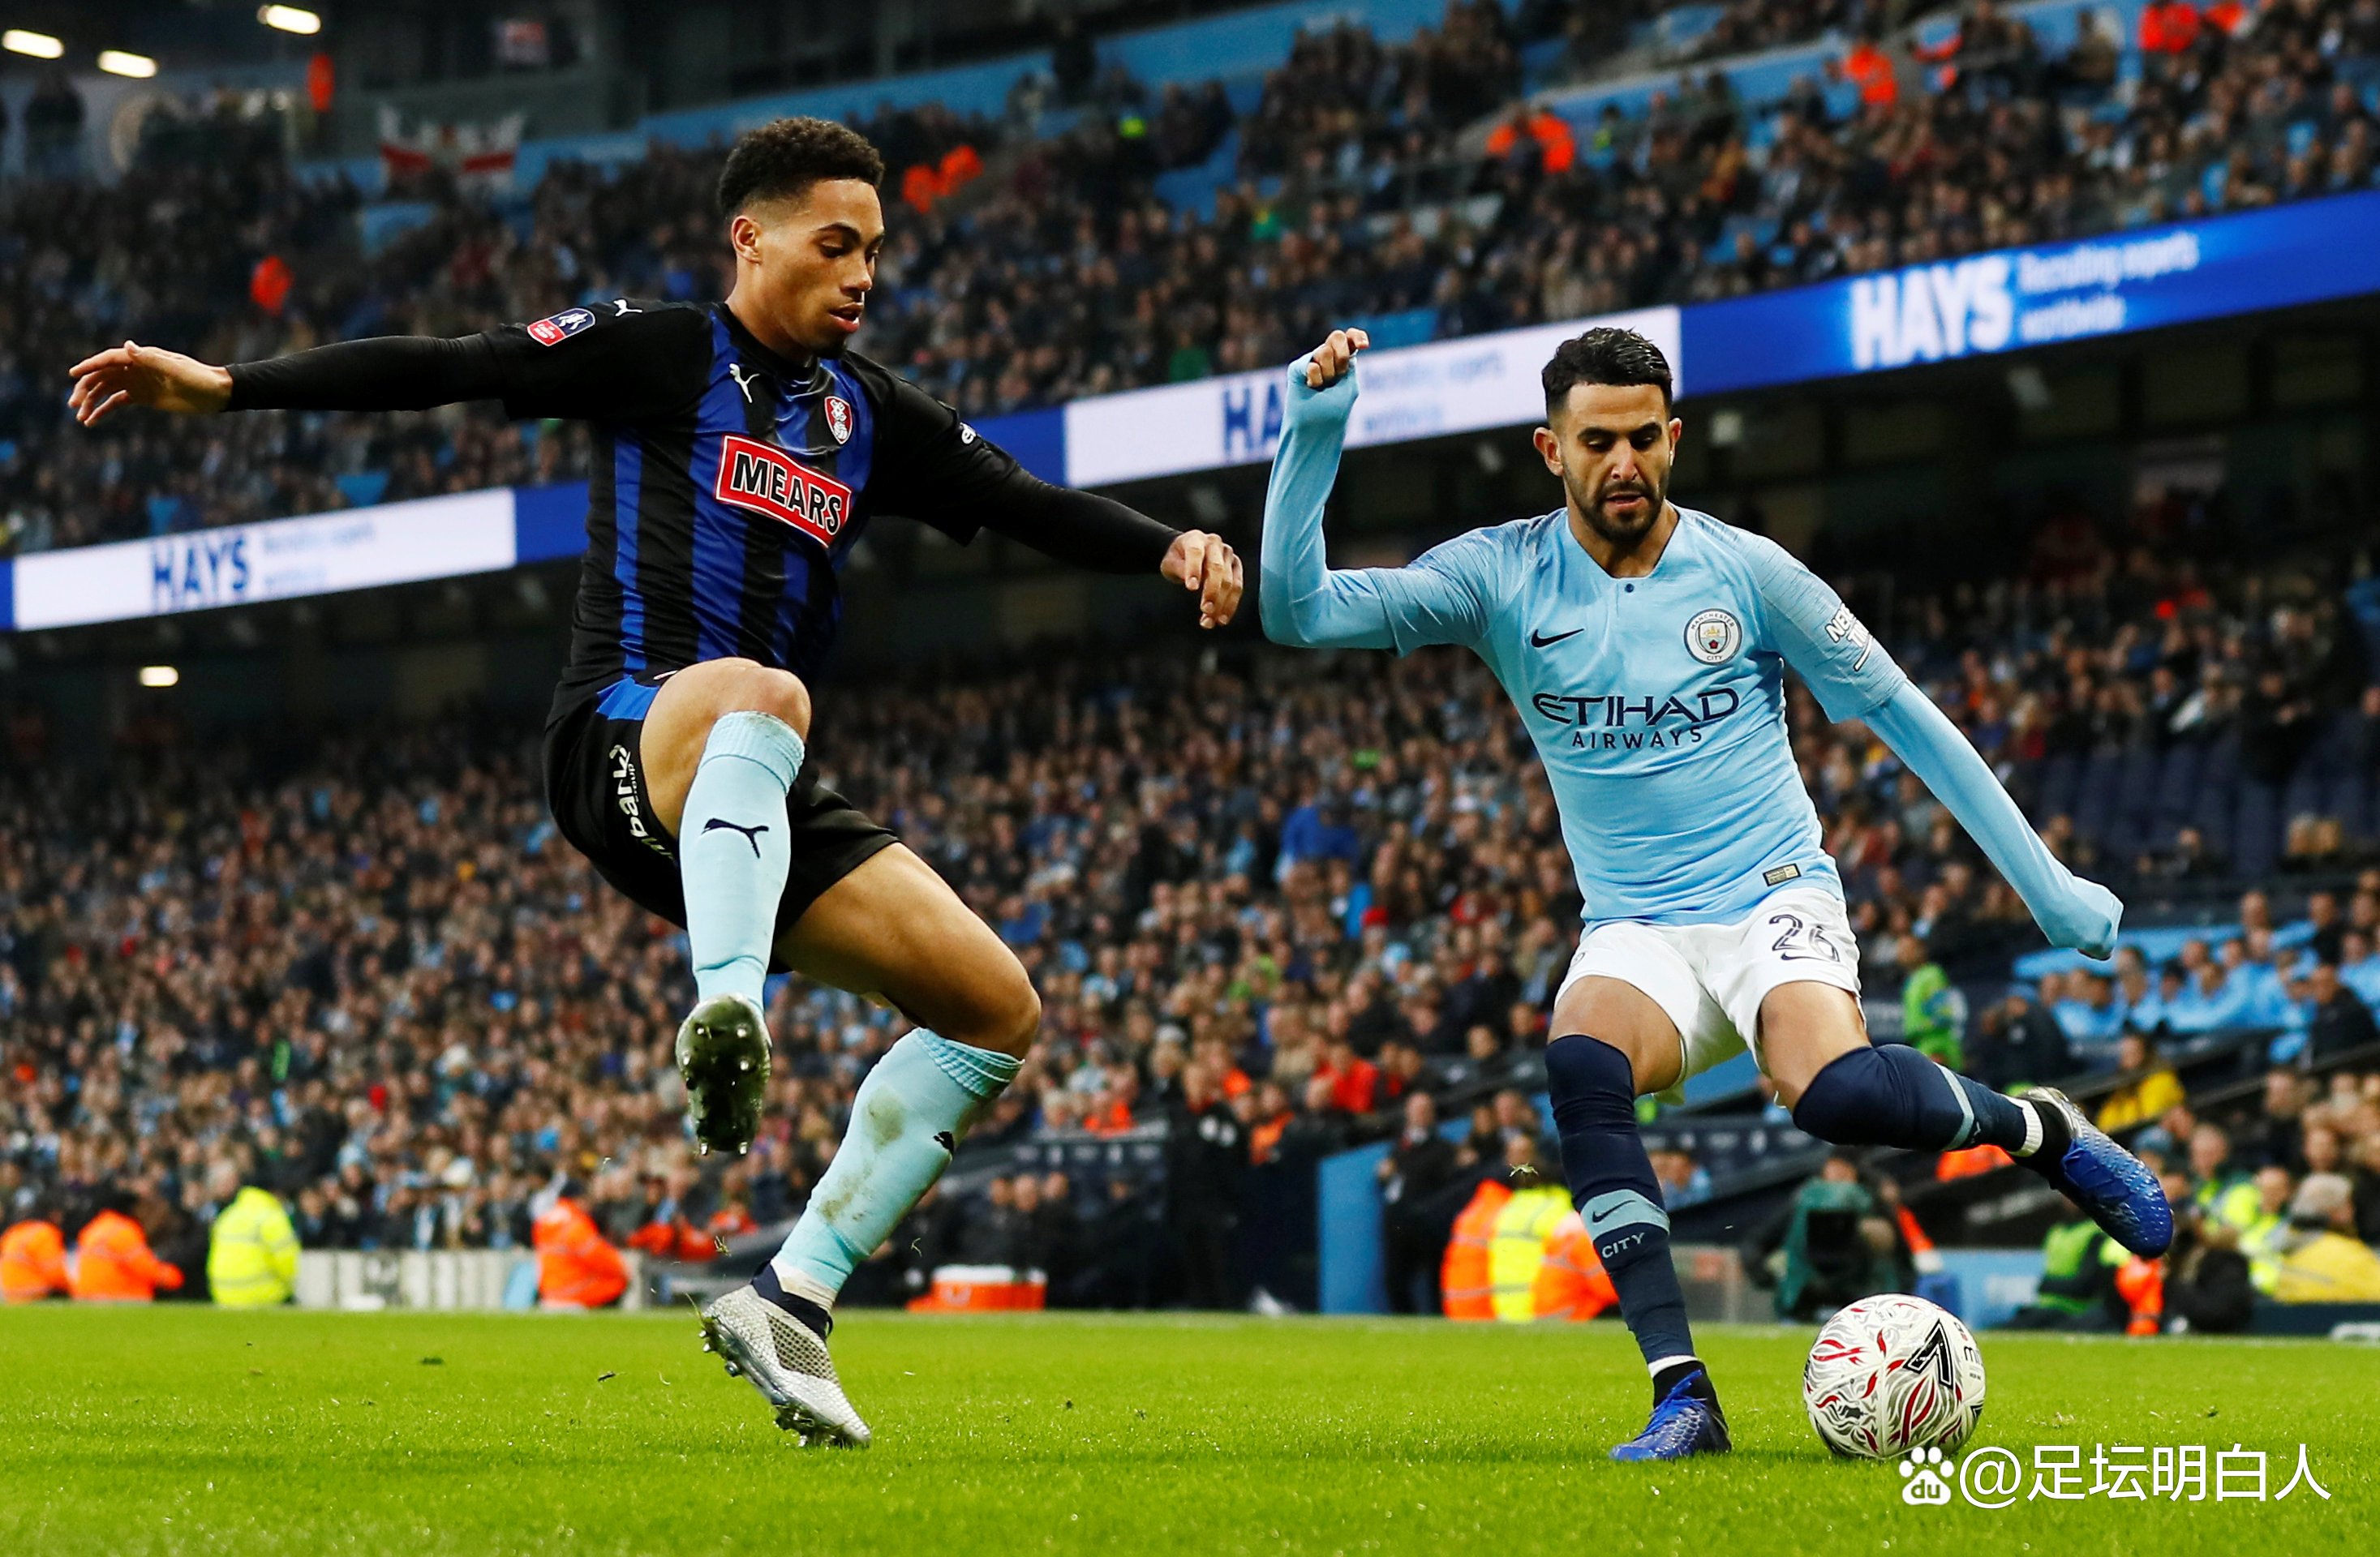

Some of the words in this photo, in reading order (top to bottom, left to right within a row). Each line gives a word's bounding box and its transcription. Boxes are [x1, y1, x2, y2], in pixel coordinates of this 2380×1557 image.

[1850, 253, 2012, 371] HAYS
[1222, 380, 1286, 461] HA
[731, 450, 842, 535] MEARS
[152, 530, 250, 610] HAYS
[1690, 613, 1735, 630] MANCHESTER
[1532, 688, 1739, 726] ETIHAD
[1572, 727, 1702, 748] AIRWAYS
[1769, 914, 1841, 962] 26
[1602, 1233, 1644, 1259] CITY
